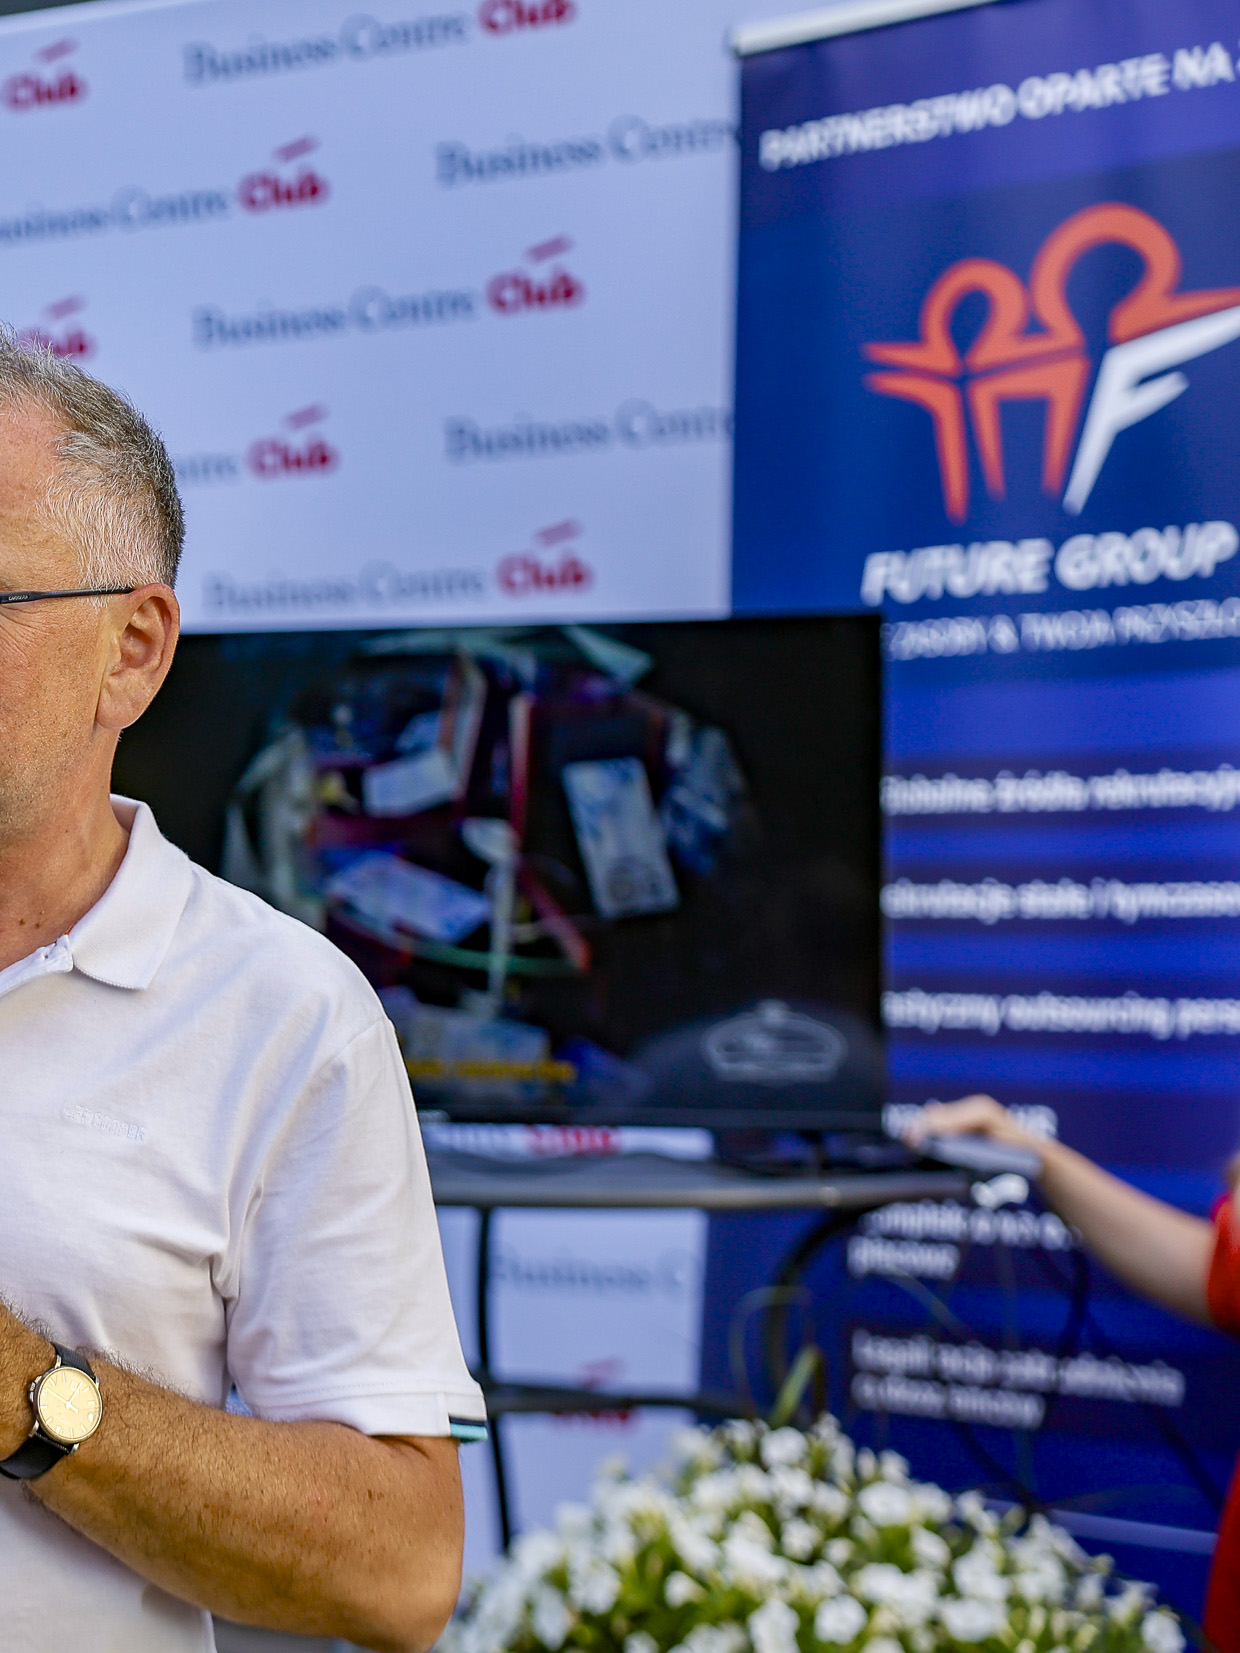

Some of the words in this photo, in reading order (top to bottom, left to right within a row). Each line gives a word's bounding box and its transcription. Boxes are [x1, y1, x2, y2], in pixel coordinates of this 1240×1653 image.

[186, 41, 338, 88] Business
[343, 15, 473, 61] Centre
[480, 0, 575, 37] Club
[3, 72, 85, 111] Club
[760, 85, 1016, 171] PARTNERSTWO
[1017, 53, 1170, 118] OPARTE
[1172, 42, 1233, 91] NA
[437, 133, 605, 189] Business
[116, 188, 229, 230] Centre
[238, 164, 330, 216] Club
[194, 307, 348, 351] Business
[352, 288, 481, 335] Centre
[486, 266, 583, 318] Club
[248, 433, 338, 480] Club
[446, 418, 613, 463] Business
[617, 401, 732, 446] Centr
[204, 573, 359, 614] Business
[362, 564, 491, 603] Centre
[496, 549, 593, 596] Club
[861, 539, 1053, 605] FUTURE
[1055, 521, 1238, 590] GROUP
